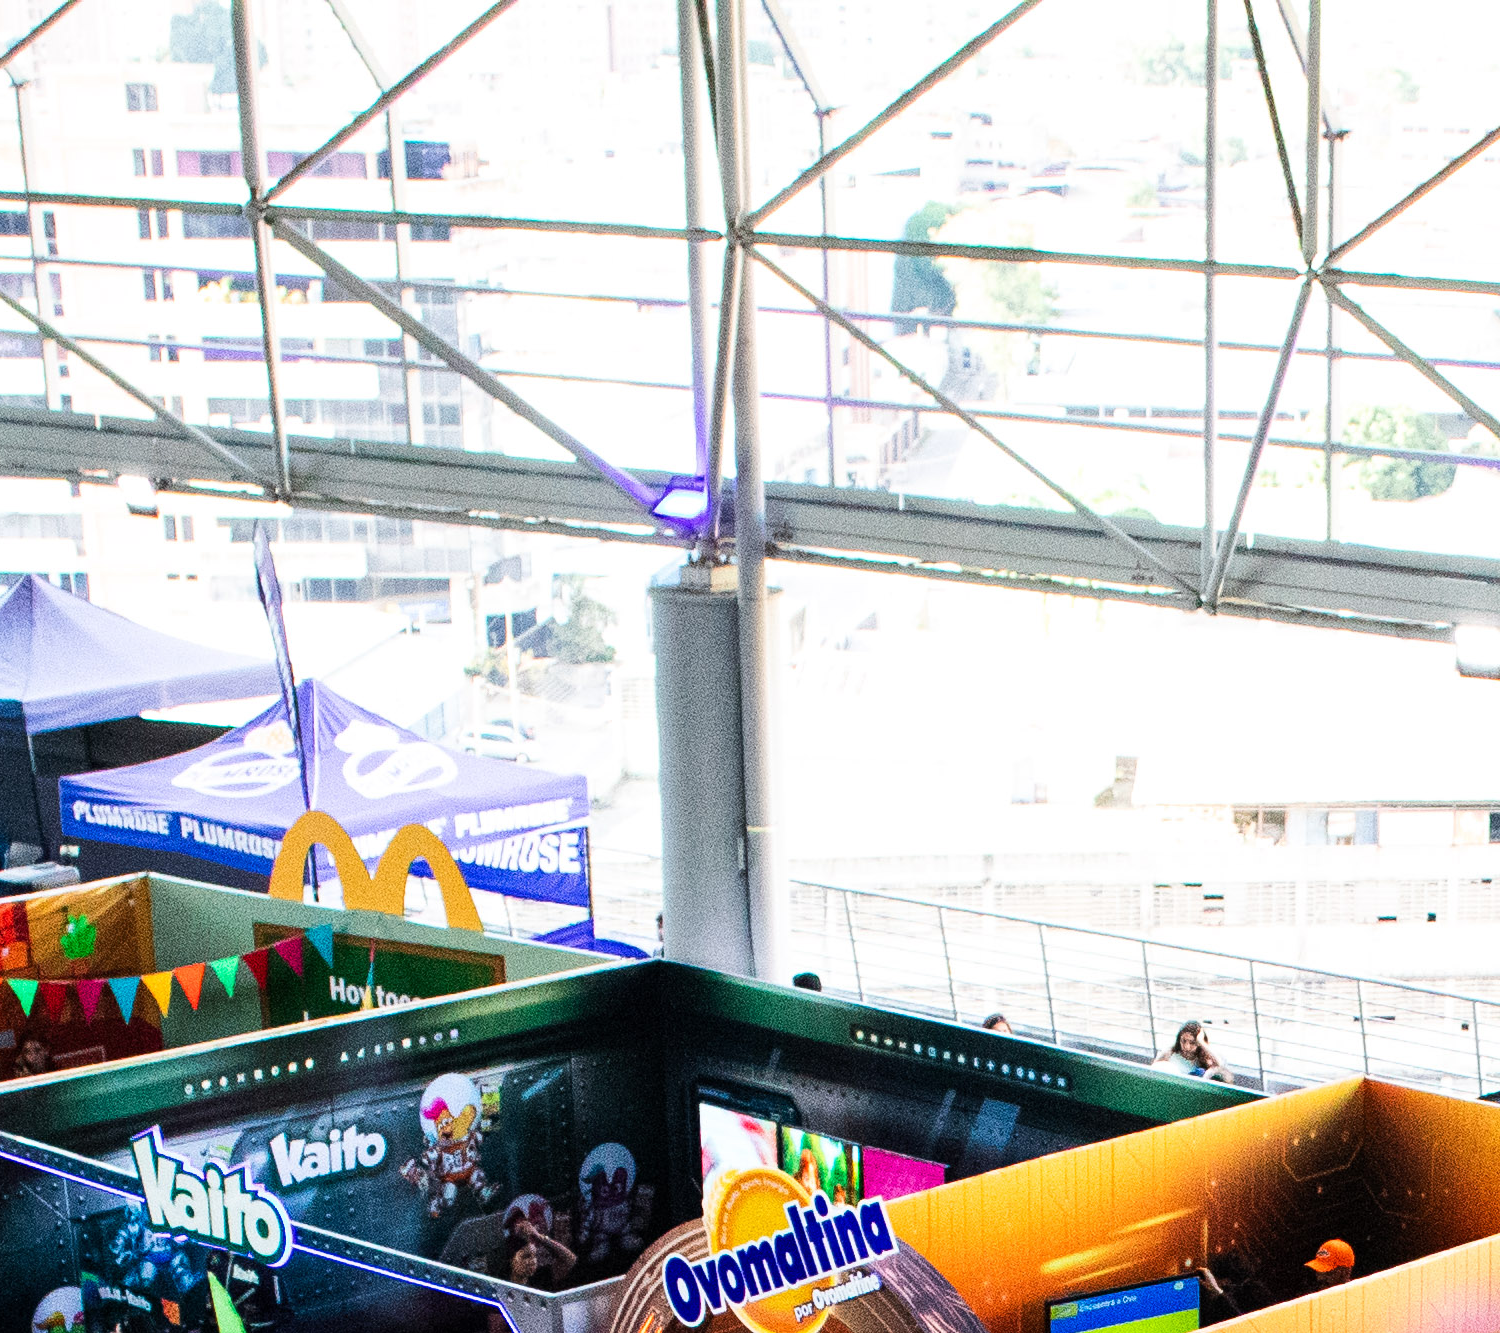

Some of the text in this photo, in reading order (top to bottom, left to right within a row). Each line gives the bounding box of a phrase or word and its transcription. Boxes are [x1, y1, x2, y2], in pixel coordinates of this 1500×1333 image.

[73, 802, 169, 835] PLUMROSE
[180, 816, 282, 860] PLUMROS
[453, 833, 581, 874] UMROSE
[665, 1194, 895, 1323] Ovomaltina
[794, 1302, 814, 1322] por
